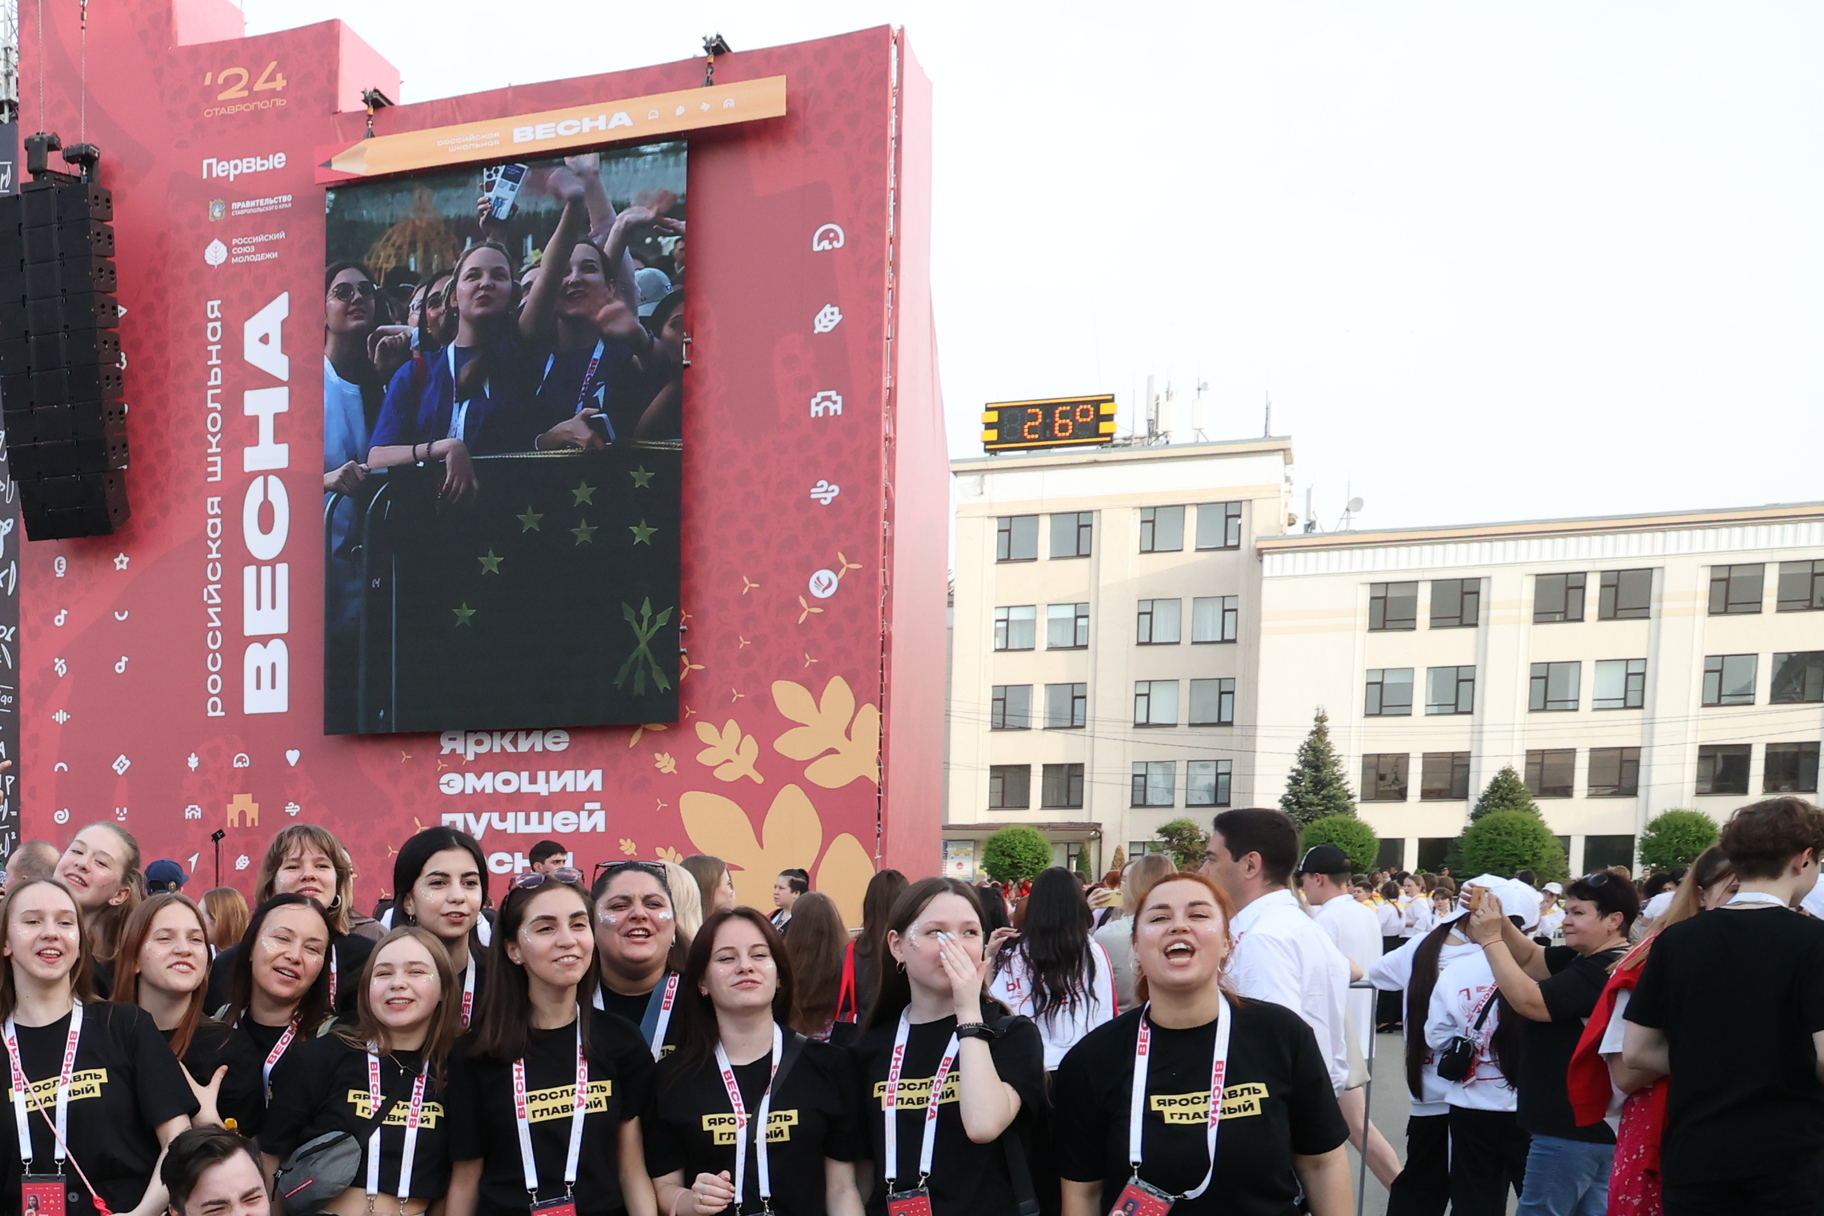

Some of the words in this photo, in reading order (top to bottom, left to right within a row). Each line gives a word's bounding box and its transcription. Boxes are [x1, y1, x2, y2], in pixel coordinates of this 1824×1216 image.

[204, 98, 287, 117] СТАВРОПОЛЬ
[512, 111, 633, 143] ВЕСНА
[437, 132, 499, 147] российская
[449, 140, 499, 152] школьная
[202, 152, 287, 181] Первые
[232, 195, 292, 209] ПРАВИТЕЛЬСТВО
[232, 231, 285, 245] РОССИЙСКИЙ
[232, 245, 255, 254] СОЮЗ
[232, 252, 278, 264] МОЛОДЕЖИ
[207, 300, 222, 481] школьная
[243, 291, 289, 714] ВЕСНА
[204, 497, 225, 716] российская
[439, 729, 570, 761] Яркие
[439, 769, 603, 796] эмоции
[60, 1030, 78, 1087] ВЕСНА
[576, 1045, 588, 1108] ВЕСНА
[887, 1044, 904, 1106] ВЕСНА
[408, 1074, 426, 1129] ВЕСНА
[514, 1058, 526, 1119] ВЕСНА
[723, 1070, 745, 1129] ВЕСНА
[927, 1056, 952, 1121] ВЕСНА
[1209, 1060, 1224, 1129] ВЕСНА
